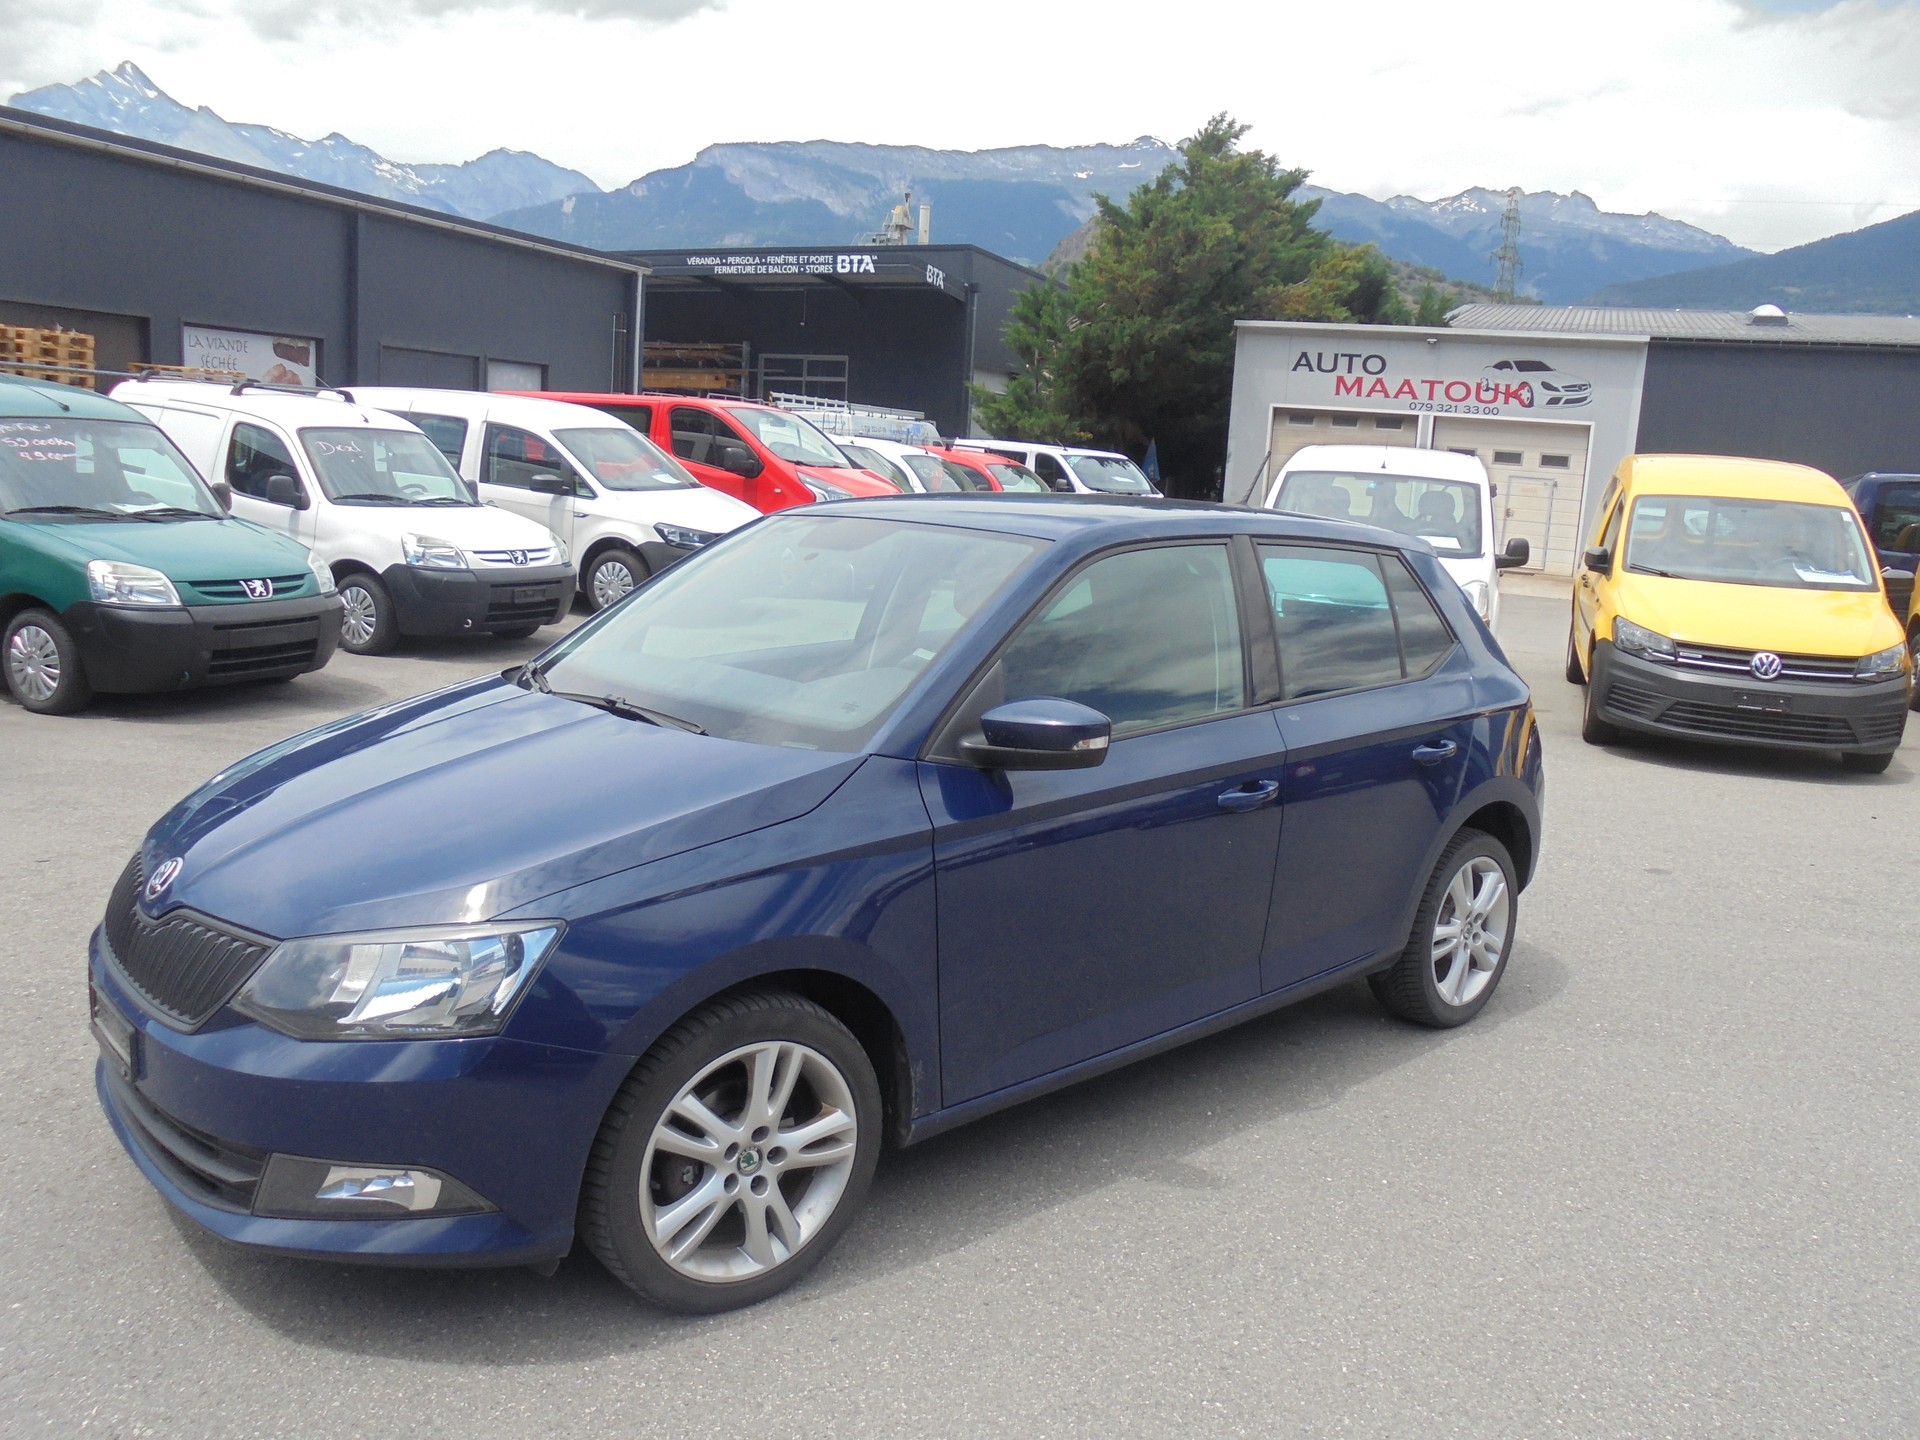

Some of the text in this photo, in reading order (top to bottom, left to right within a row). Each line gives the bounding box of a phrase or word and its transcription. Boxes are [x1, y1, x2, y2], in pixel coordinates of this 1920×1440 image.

[686, 254, 833, 265] VÉRANDA PERGOLA FENÊTRE ET PORTE
[714, 264, 833, 274] FERMETURE DE BALCON STORES
[836, 255, 875, 273] BTA
[926, 264, 944, 290] BTA
[188, 334, 249, 354] LA VIANDE
[200, 351, 238, 371] SÉCHÉE
[1291, 351, 1387, 375] AUTO
[1334, 375, 1529, 408] MAATOUK
[1409, 402, 1500, 416] 079 321 33 00
